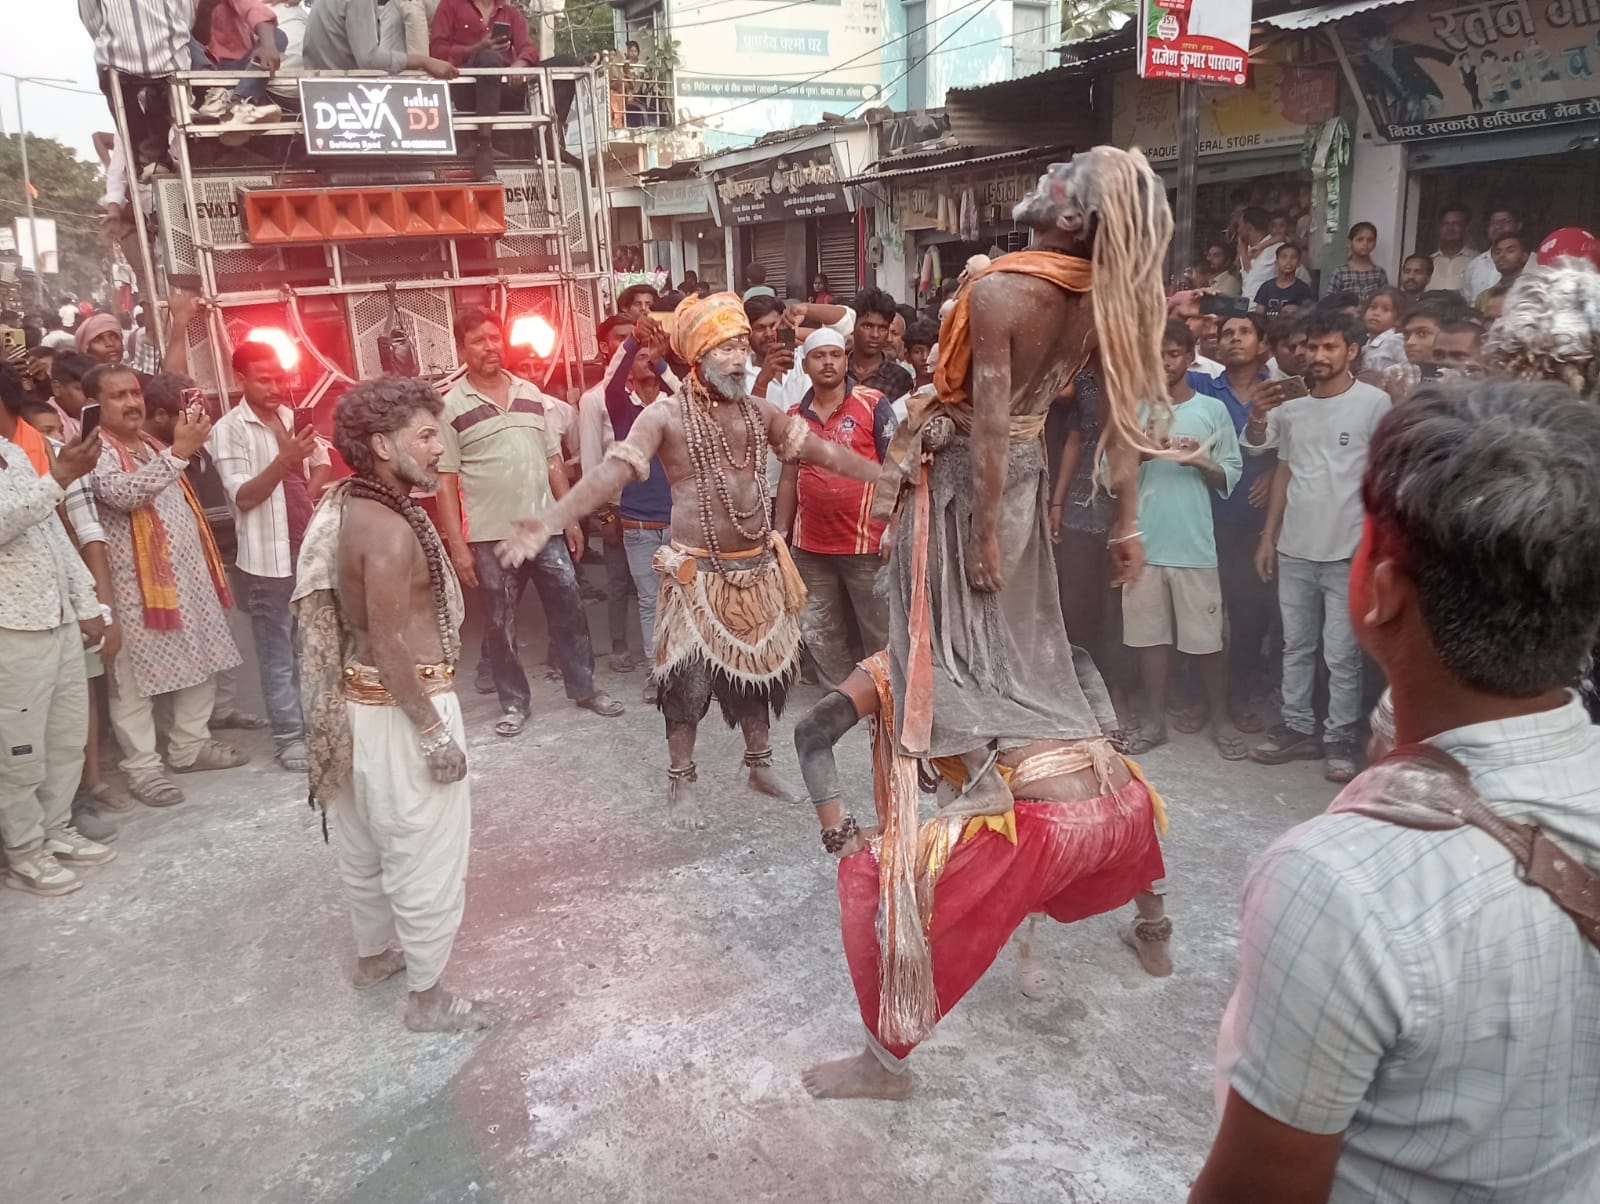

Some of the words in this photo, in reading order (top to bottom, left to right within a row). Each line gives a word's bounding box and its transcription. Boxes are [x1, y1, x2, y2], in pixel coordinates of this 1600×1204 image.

[1162, 15, 1175, 25] 357
[1430, 0, 1536, 51] रतन
[1546, 0, 1600, 28] गा
[1151, 44, 1179, 66] राजेश
[1180, 51, 1206, 71] कुमार
[1208, 54, 1243, 72] पासवान
[313, 91, 403, 140] DEVA
[407, 107, 440, 130] DJ
[1388, 123, 1424, 138] नियर
[1426, 114, 1480, 135] सरकारी
[1552, 103, 1582, 118] मेन
[1585, 99, 1600, 116] रो
[1227, 134, 1261, 150] STORE
